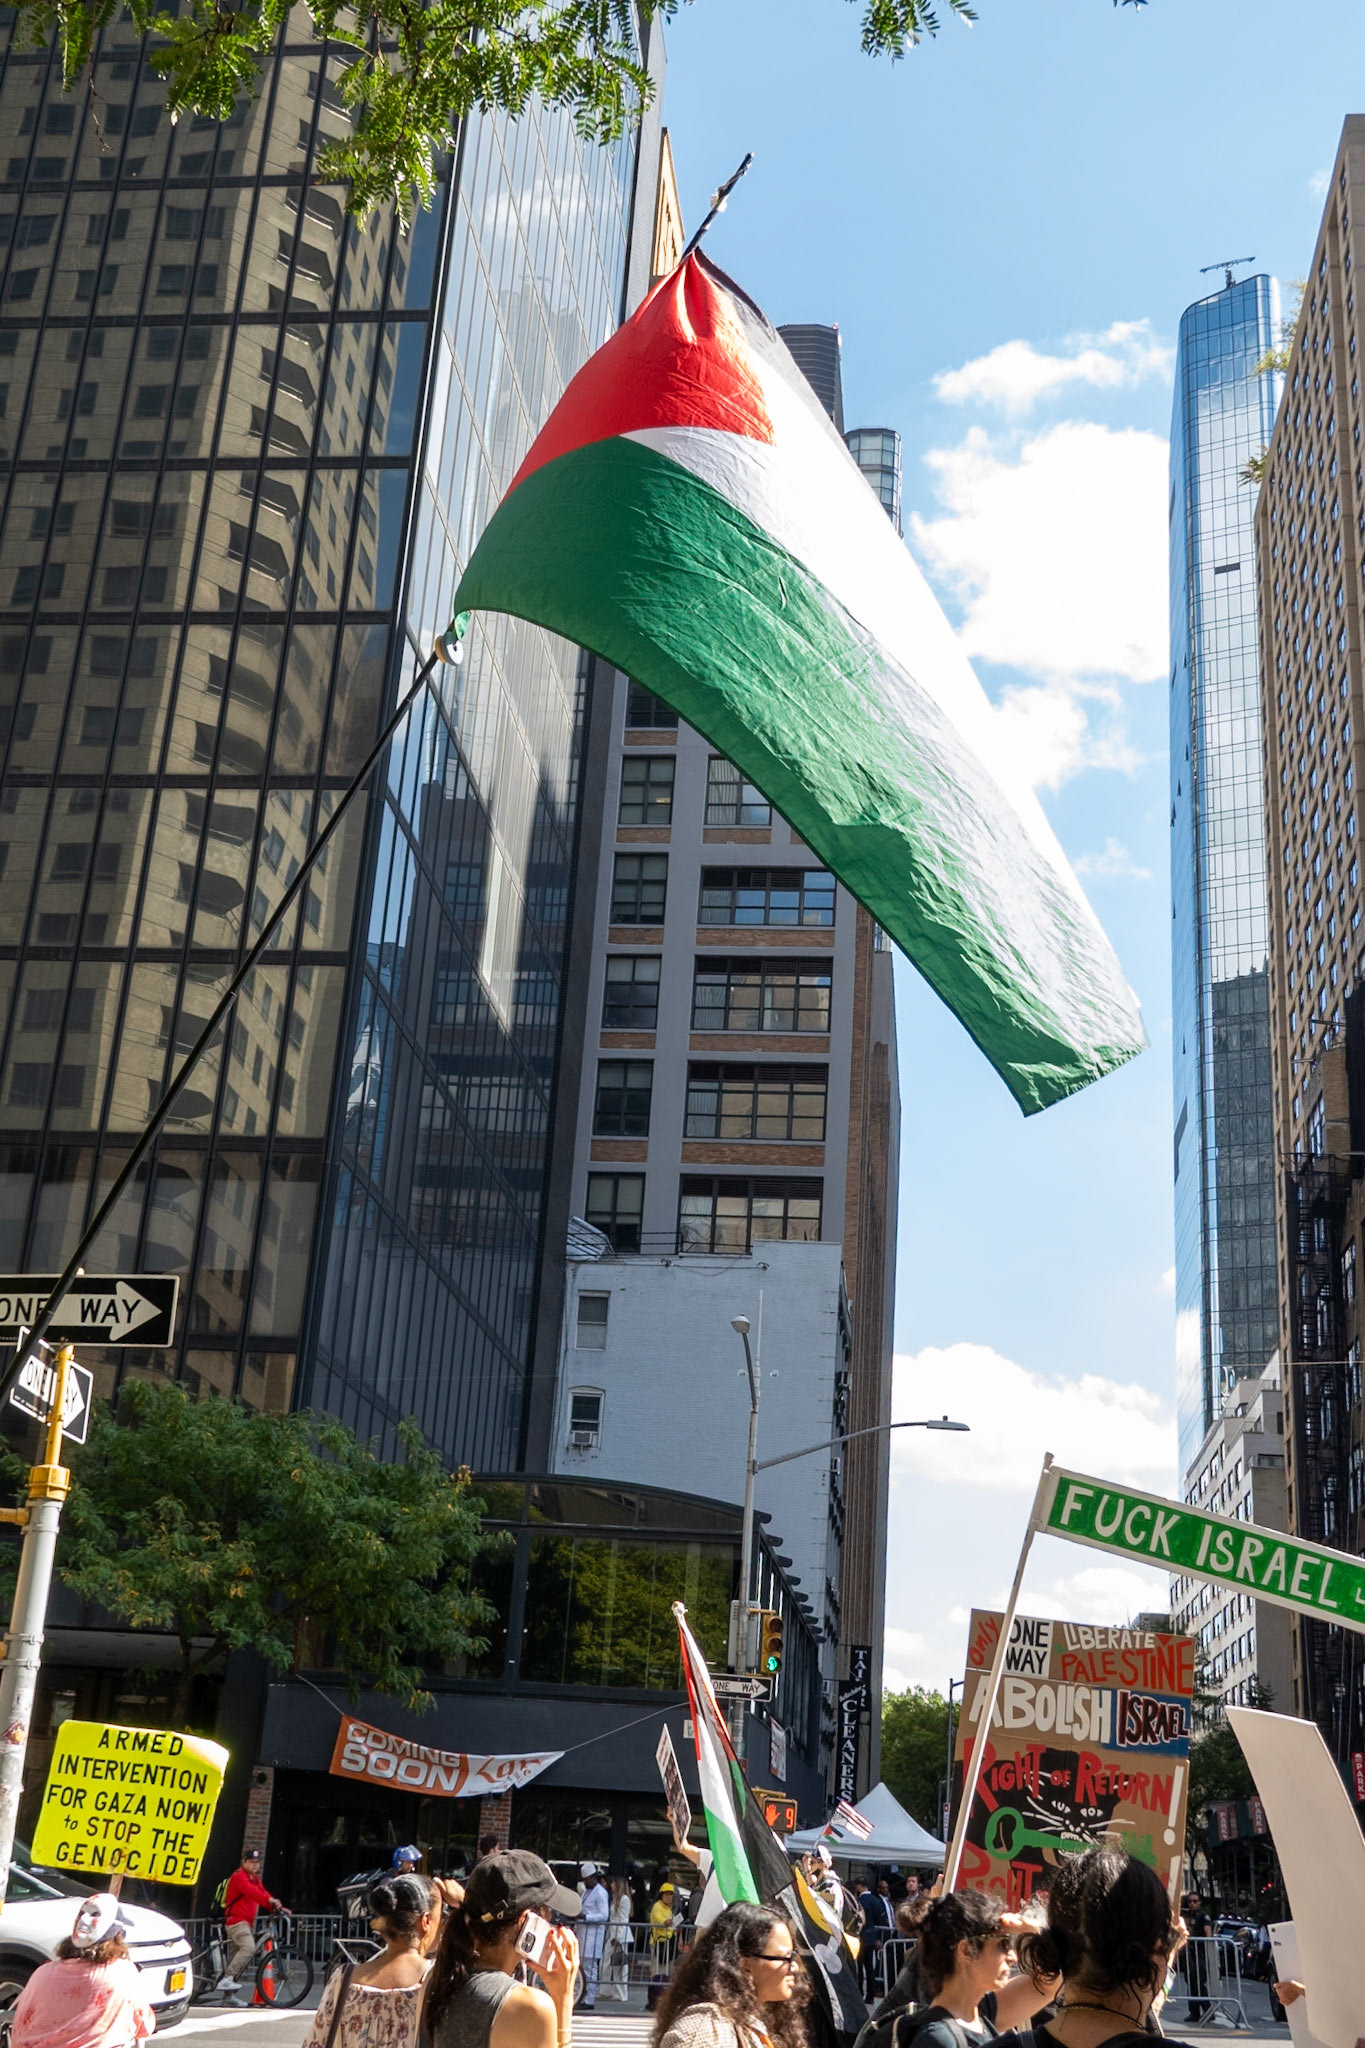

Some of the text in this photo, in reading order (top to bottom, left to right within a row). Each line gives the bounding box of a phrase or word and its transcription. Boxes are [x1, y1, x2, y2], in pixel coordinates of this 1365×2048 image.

[80, 1299, 141, 1323] WAY
[1060, 1484, 1337, 1608] FUCK ISRAEL
[1009, 1618, 1050, 1648] ONE
[1063, 1623, 1155, 1651] LIBERATE
[1005, 1647, 1047, 1674] WAY
[1061, 1639, 1194, 1695] PALESTINE
[713, 1681, 760, 1693] ONE WAY
[968, 1675, 1190, 1748] ABOLISH ISRAEL
[98, 1728, 183, 1757] ARMED
[346, 1723, 460, 1769] COMING
[840, 1699, 857, 1803] CLEANERS
[58, 1754, 207, 1794] INTERVENTION
[340, 1742, 463, 1791] SOON
[962, 1737, 1047, 1813] RIGHT
[47, 1784, 210, 1825] FOR GAZA NOW!
[785, 1808, 795, 1828] 9
[64, 1814, 194, 1855] to STOP THE
